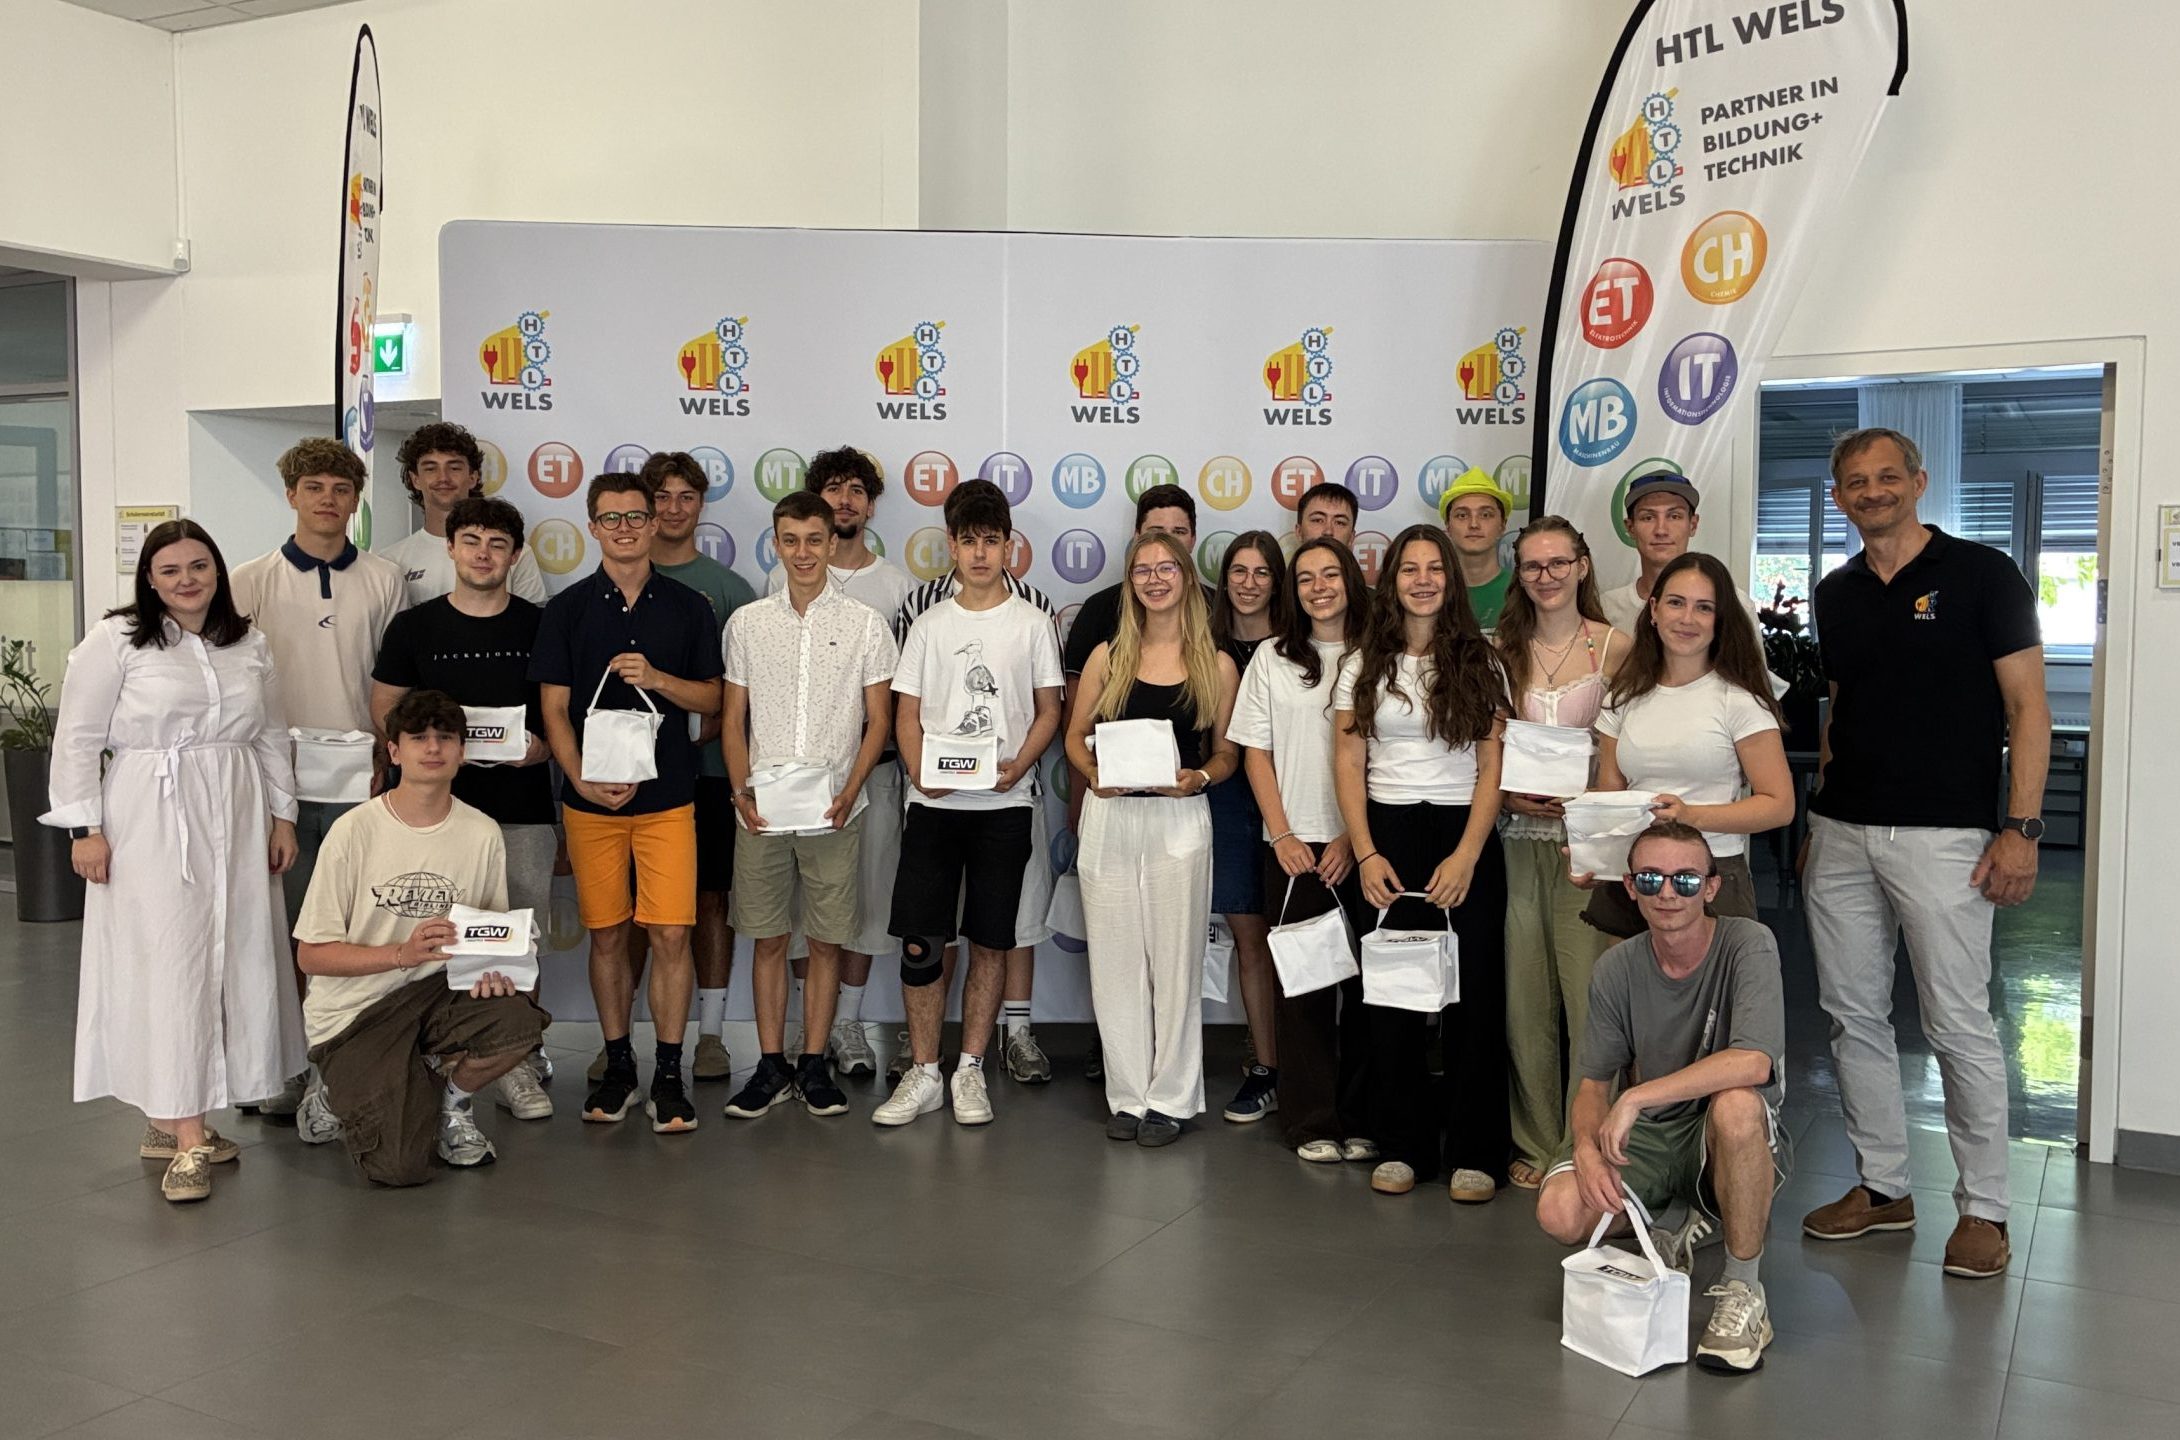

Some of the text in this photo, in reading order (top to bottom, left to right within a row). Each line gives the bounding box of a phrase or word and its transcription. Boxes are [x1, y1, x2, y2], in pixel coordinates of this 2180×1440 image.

[1656, 0, 1845, 67] HTL WELS
[1701, 76, 1839, 125] PARTNER IN
[1703, 112, 1823, 154] BILDUNG+
[1704, 143, 1803, 182] TECHNIK
[1612, 185, 1686, 220] WELS
[1694, 232, 1754, 284] CH
[1589, 277, 1639, 326] ET
[1679, 353, 1721, 400] IT
[481, 391, 553, 411] WELS
[679, 397, 750, 417] WELS
[877, 402, 947, 421] WELS
[1071, 405, 1141, 424] WELS
[1263, 408, 1332, 426] WELS
[1455, 407, 1526, 426] WELS
[1569, 396, 1628, 445] MB
[481, 456, 499, 483] H
[537, 454, 574, 483] ET
[761, 461, 802, 489] MT
[913, 464, 949, 492] ET
[992, 465, 1019, 492] IT
[1059, 466, 1100, 495] MB
[1280, 469, 1315, 496] ET
[1359, 468, 1386, 496] IT
[1207, 469, 1243, 497] CH
[537, 533, 577, 560] CH
[914, 540, 949, 568] CH
[1010, 540, 1023, 568] T
[1066, 541, 1093, 569] IT
[1353, 543, 1387, 571] ET
[466, 727, 503, 738] TGW
[940, 759, 975, 769] TGW
[372, 886, 466, 907] REVIEW
[468, 927, 507, 937] TGW
